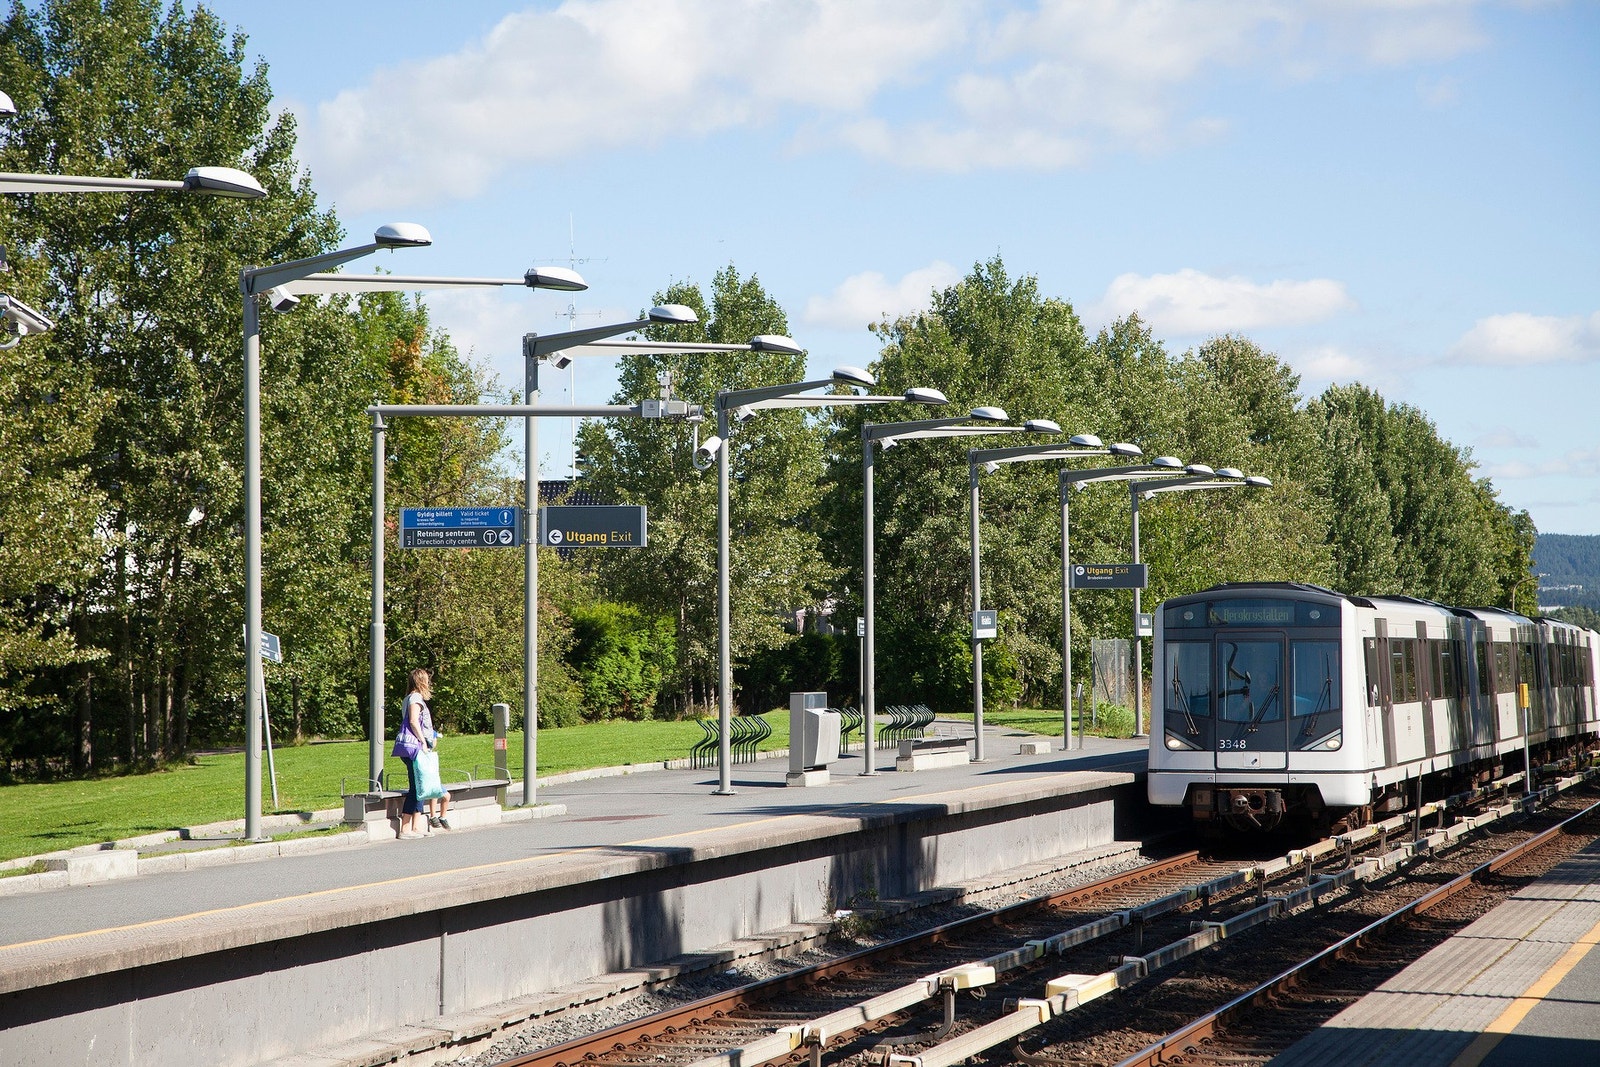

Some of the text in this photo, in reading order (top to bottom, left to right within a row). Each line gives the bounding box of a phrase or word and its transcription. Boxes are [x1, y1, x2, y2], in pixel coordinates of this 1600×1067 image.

[417, 530, 443, 538] Retning
[566, 531, 632, 544] Utgang Exit
[1086, 567, 1113, 575] Utgang
[1224, 609, 1289, 621] Bergkrystallen
[1219, 739, 1246, 749] 3348
